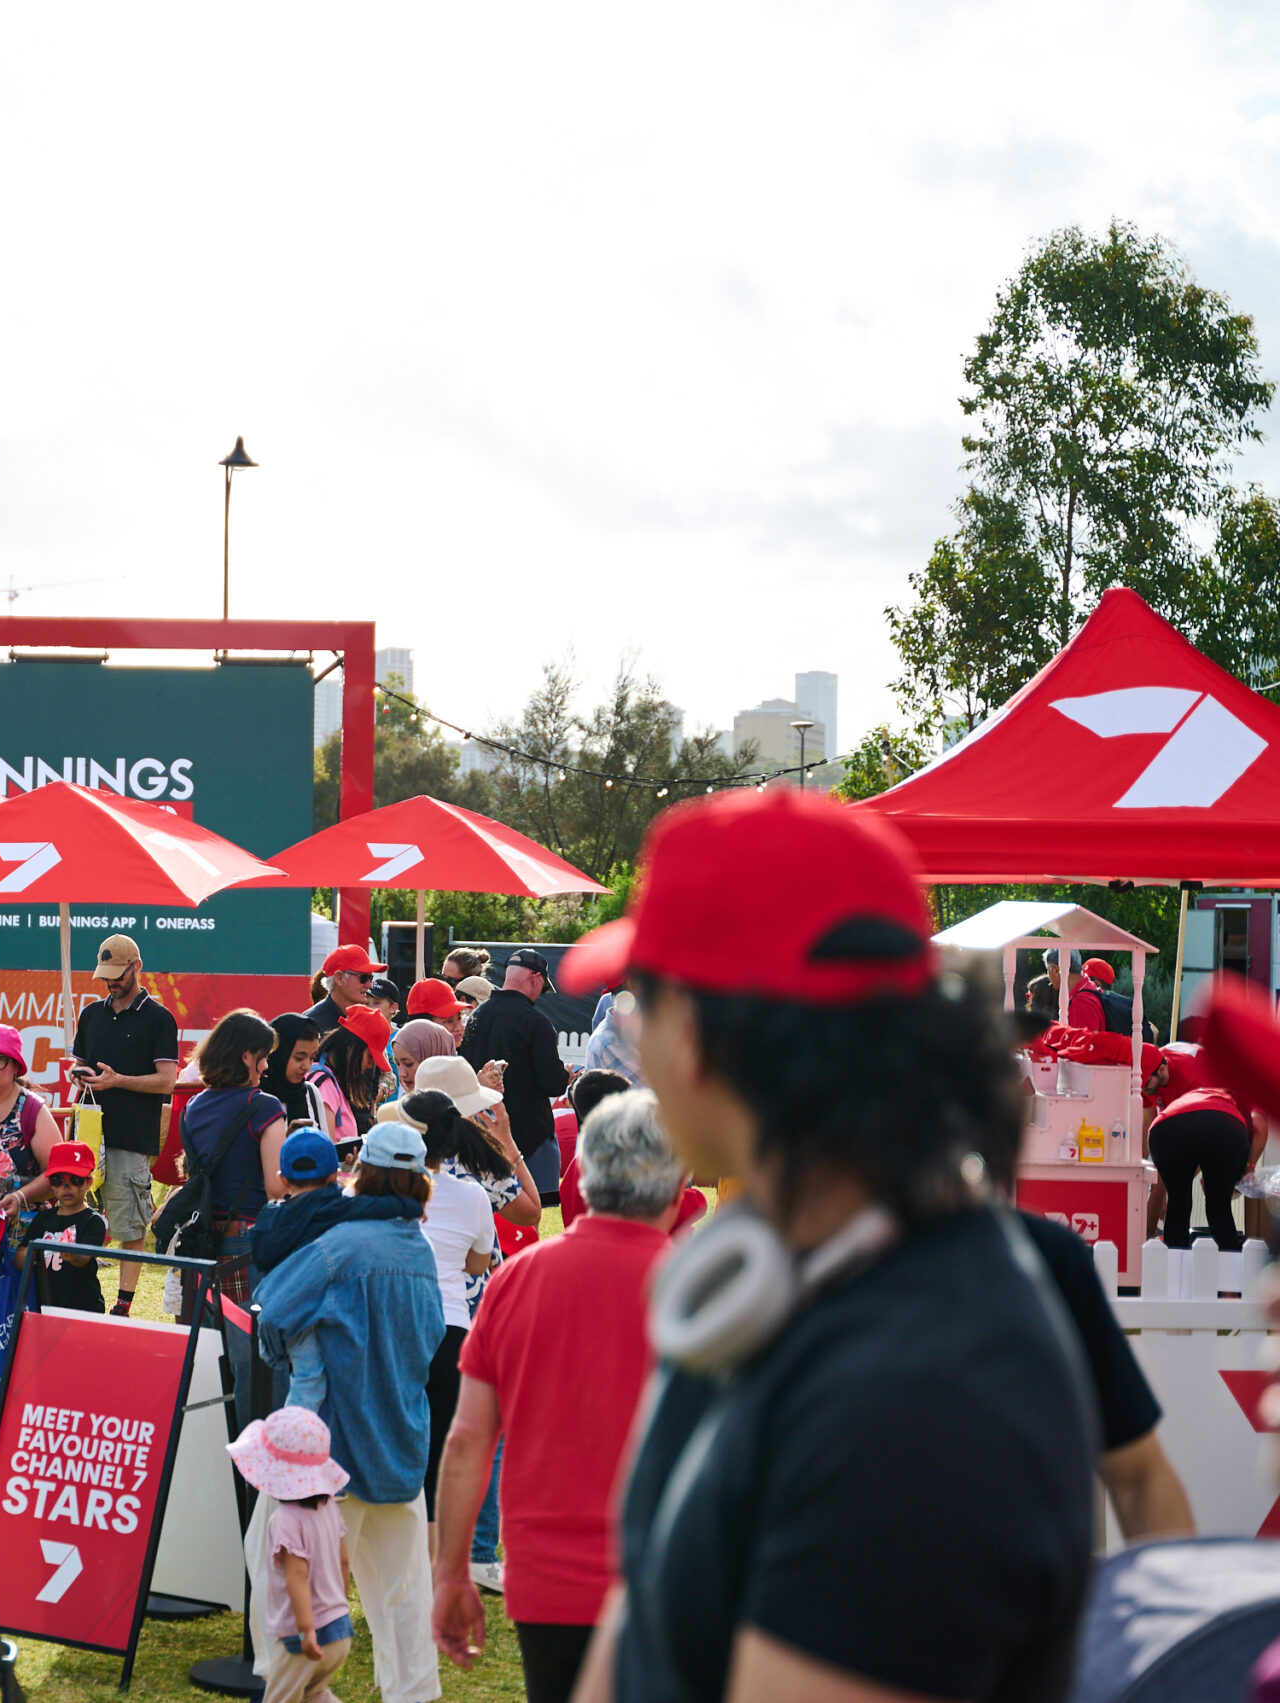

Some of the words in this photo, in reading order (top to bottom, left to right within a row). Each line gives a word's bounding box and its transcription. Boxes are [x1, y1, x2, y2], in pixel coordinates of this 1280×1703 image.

[359, 842, 425, 882] 7
[111, 916, 137, 929] APP
[156, 917, 216, 930] ONEPASS
[1074, 1218, 1098, 1234] 7+
[21, 1403, 84, 1433] MEET
[89, 1413, 155, 1445] YOUR
[18, 1427, 150, 1469] FAVOURITE
[11, 1450, 125, 1490] CHANNEL
[131, 1470, 148, 1492] 7
[2, 1475, 142, 1535] STARS
[35, 1538, 84, 1604] 7
